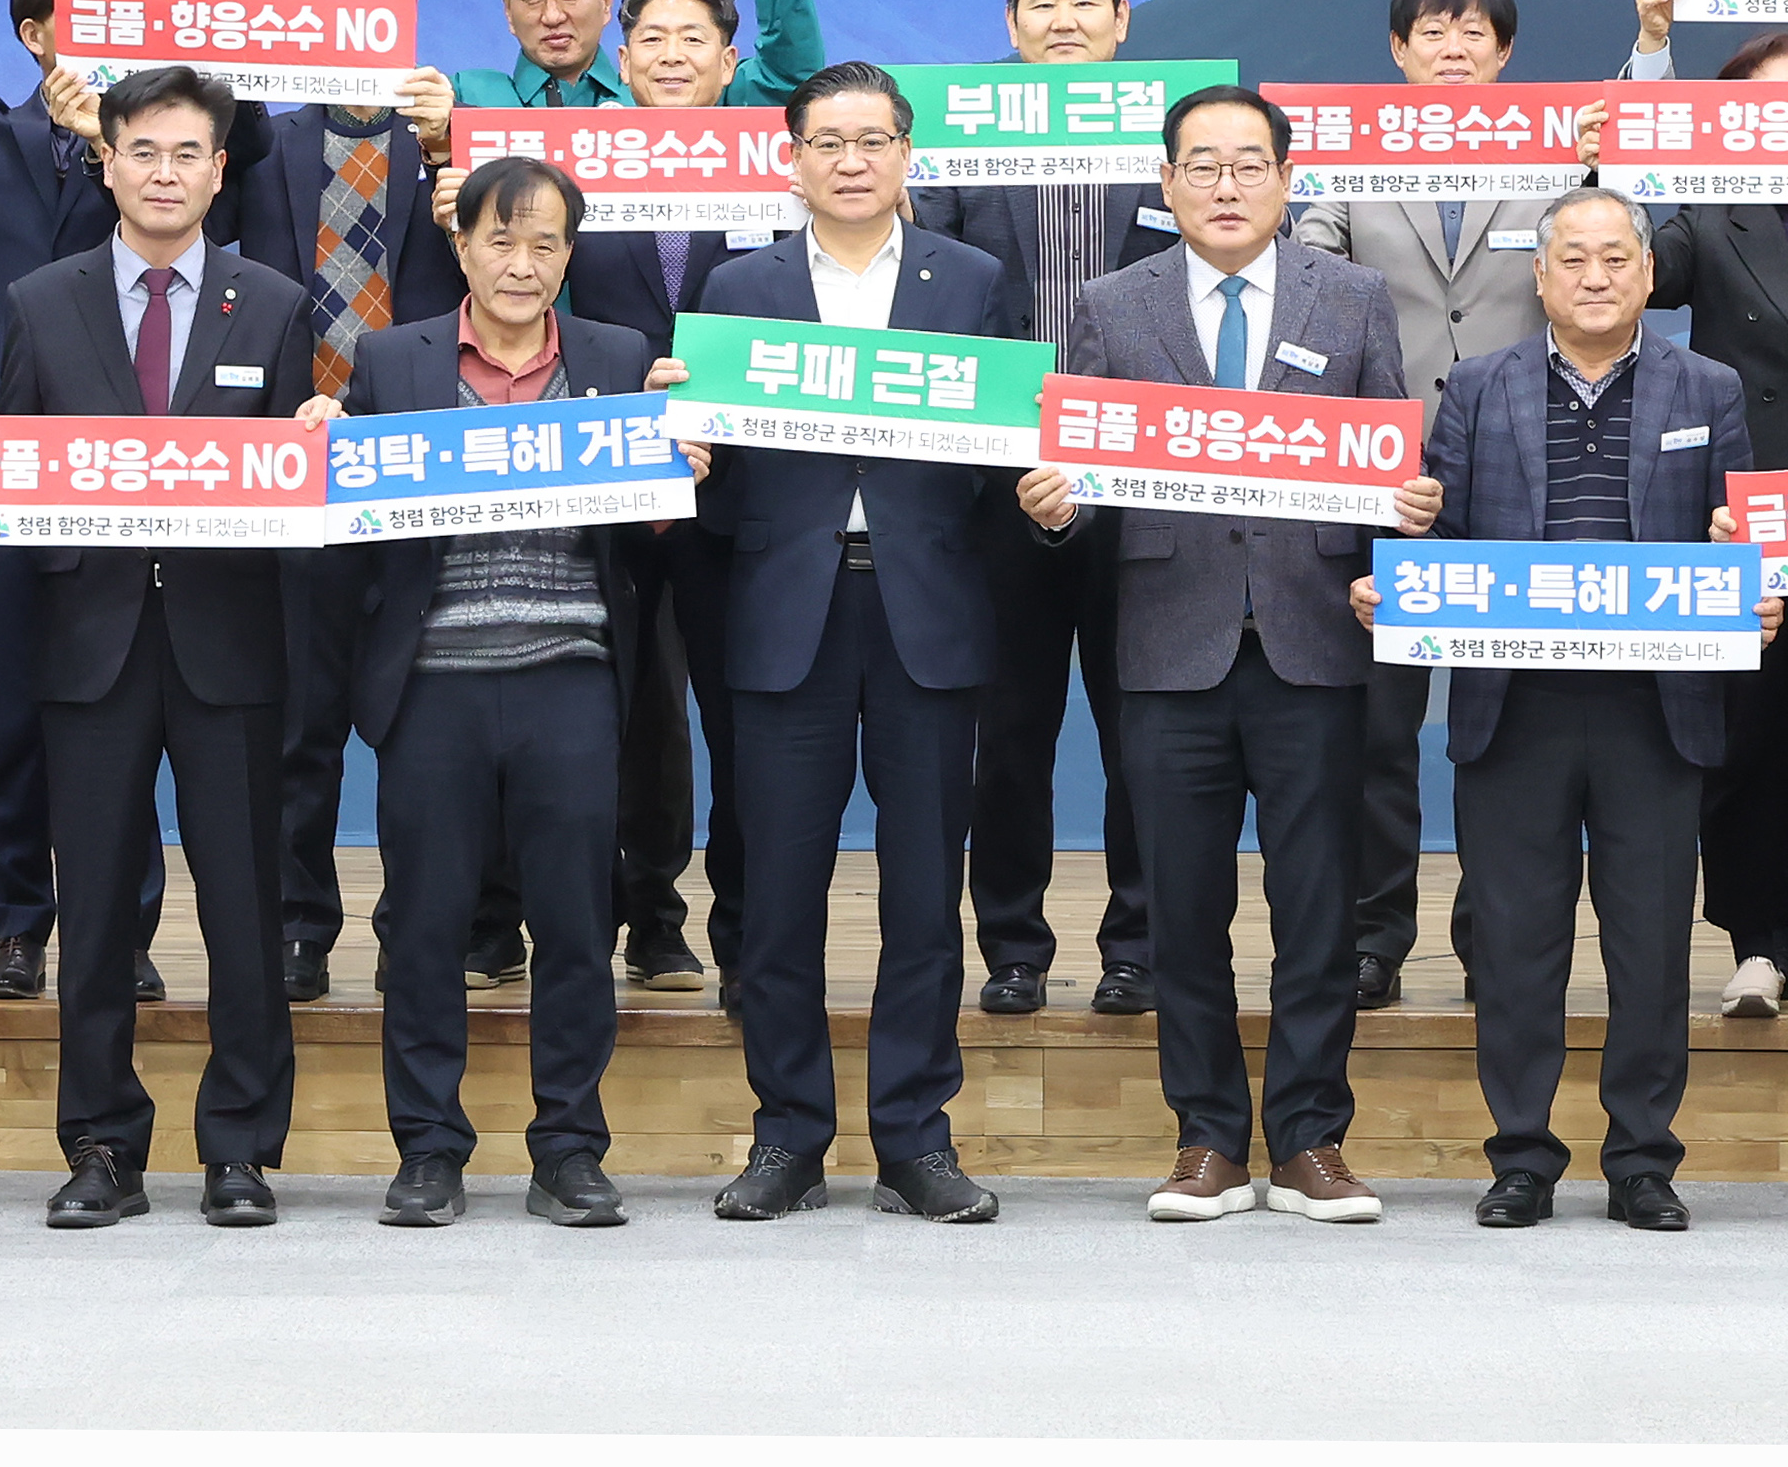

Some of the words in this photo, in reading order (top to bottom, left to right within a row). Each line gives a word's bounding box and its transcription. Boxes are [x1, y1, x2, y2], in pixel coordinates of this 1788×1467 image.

[335, 8, 399, 54] NO
[944, 83, 1049, 135] 부패
[1065, 80, 1167, 133] 근절
[1330, 175, 1364, 193] 청렴
[1369, 174, 1421, 192] 함양군
[1425, 174, 1494, 192] 공직자가
[744, 339, 858, 401] 부패
[869, 349, 980, 410] 근절
[741, 416, 778, 439] 청렴
[780, 419, 837, 444] 함양군
[840, 424, 913, 450] 공직자가
[1337, 421, 1406, 472] NO
[242, 442, 309, 491] NO
[1110, 477, 1147, 498] 청렴
[1150, 480, 1207, 503] 함양군
[1210, 484, 1284, 508] 공직자가
[16, 516, 52, 535] 청렴
[57, 516, 113, 536] 함양군
[117, 516, 189, 536] 공직자가
[388, 507, 425, 529] 청렴
[429, 503, 484, 526] 함양군
[488, 498, 561, 522] 공직자가
[1645, 566, 1741, 617] 거절
[1449, 638, 1485, 658] 청렴
[1490, 638, 1545, 659] 함양군
[1550, 640, 1623, 661] 공직자가
